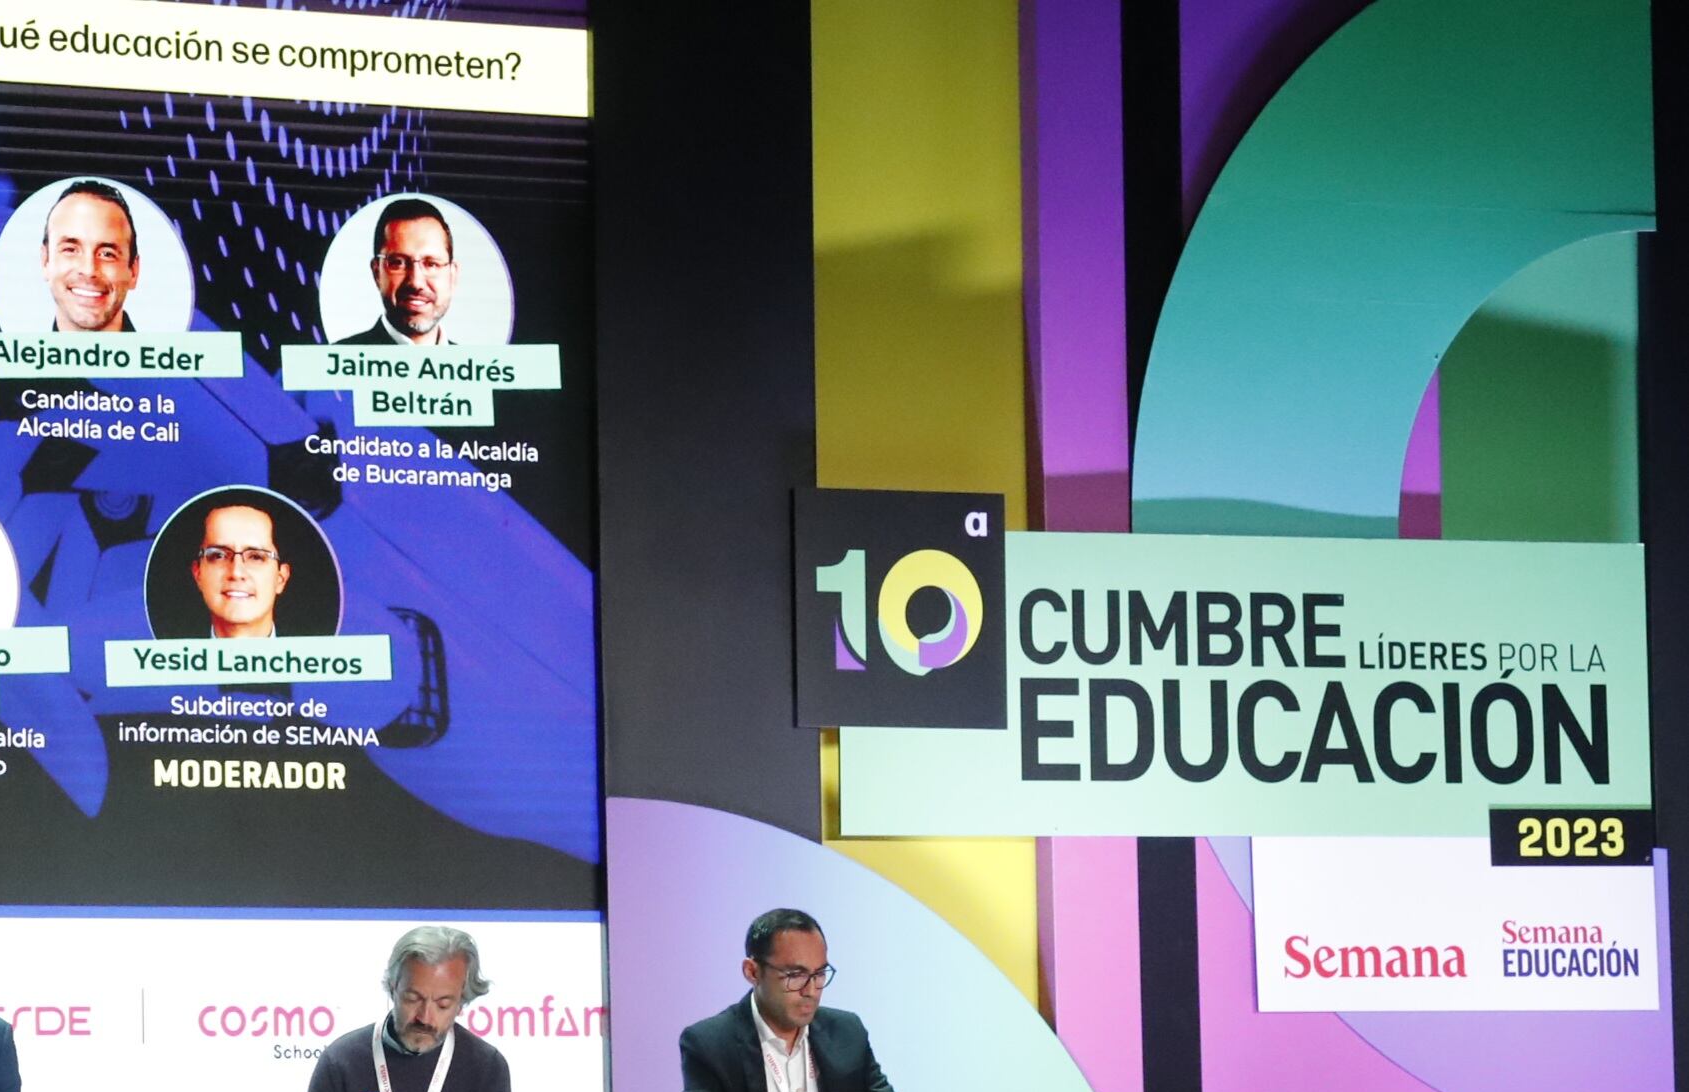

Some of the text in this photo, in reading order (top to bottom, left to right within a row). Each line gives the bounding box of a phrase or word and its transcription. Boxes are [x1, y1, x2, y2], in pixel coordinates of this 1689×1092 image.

[49, 28, 223, 62] educación
[232, 40, 271, 65] se
[278, 43, 521, 81] comprometen?
[140, 346, 204, 371] Eder
[326, 353, 515, 383] Jaime Andrés
[21, 389, 175, 414] Candidato a la
[372, 390, 472, 416] Beltrán
[17, 417, 179, 443] Alcaldía de Cali
[304, 434, 539, 463] Candidato a la Alcaldía
[333, 463, 512, 492] de Bucaramanga
[1018, 588, 1606, 673] CUMBRE LÍDERES POR LA
[133, 647, 362, 675] Yesid Lancheros
[170, 695, 328, 718] Subdirector de
[119, 722, 380, 747] información de SEMANA
[1020, 666, 1610, 785] EDUCACIÓN
[153, 758, 347, 790] MODERADOR
[1518, 817, 1625, 858] 2023
[1501, 919, 1603, 944] Semana
[1283, 935, 1468, 979] Semana
[1502, 941, 1640, 978] EDUCACIÓN
[273, 1044, 328, 1059] Schoo
